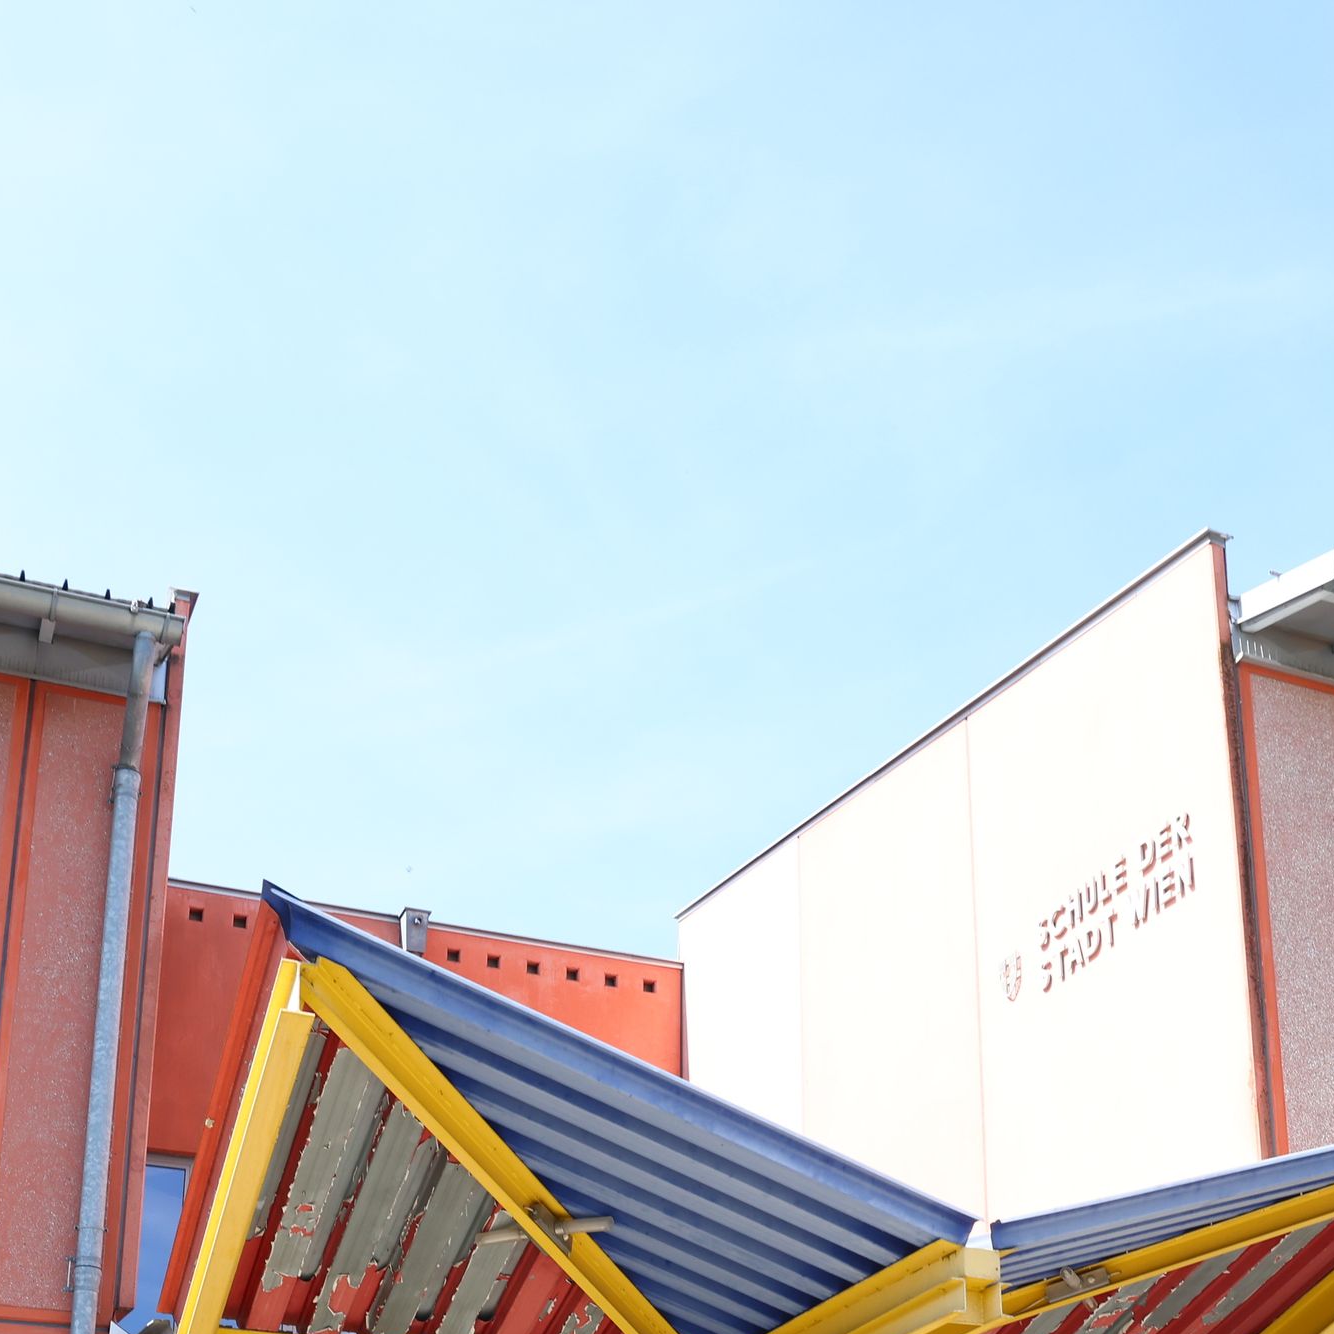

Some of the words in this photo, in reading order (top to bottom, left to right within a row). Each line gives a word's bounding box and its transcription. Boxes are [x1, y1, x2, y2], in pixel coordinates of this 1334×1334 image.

[1038, 855, 1128, 951] SCHULE
[1139, 811, 1194, 877] DER
[1040, 909, 1118, 993] STADT
[1127, 853, 1196, 930] WIEN
